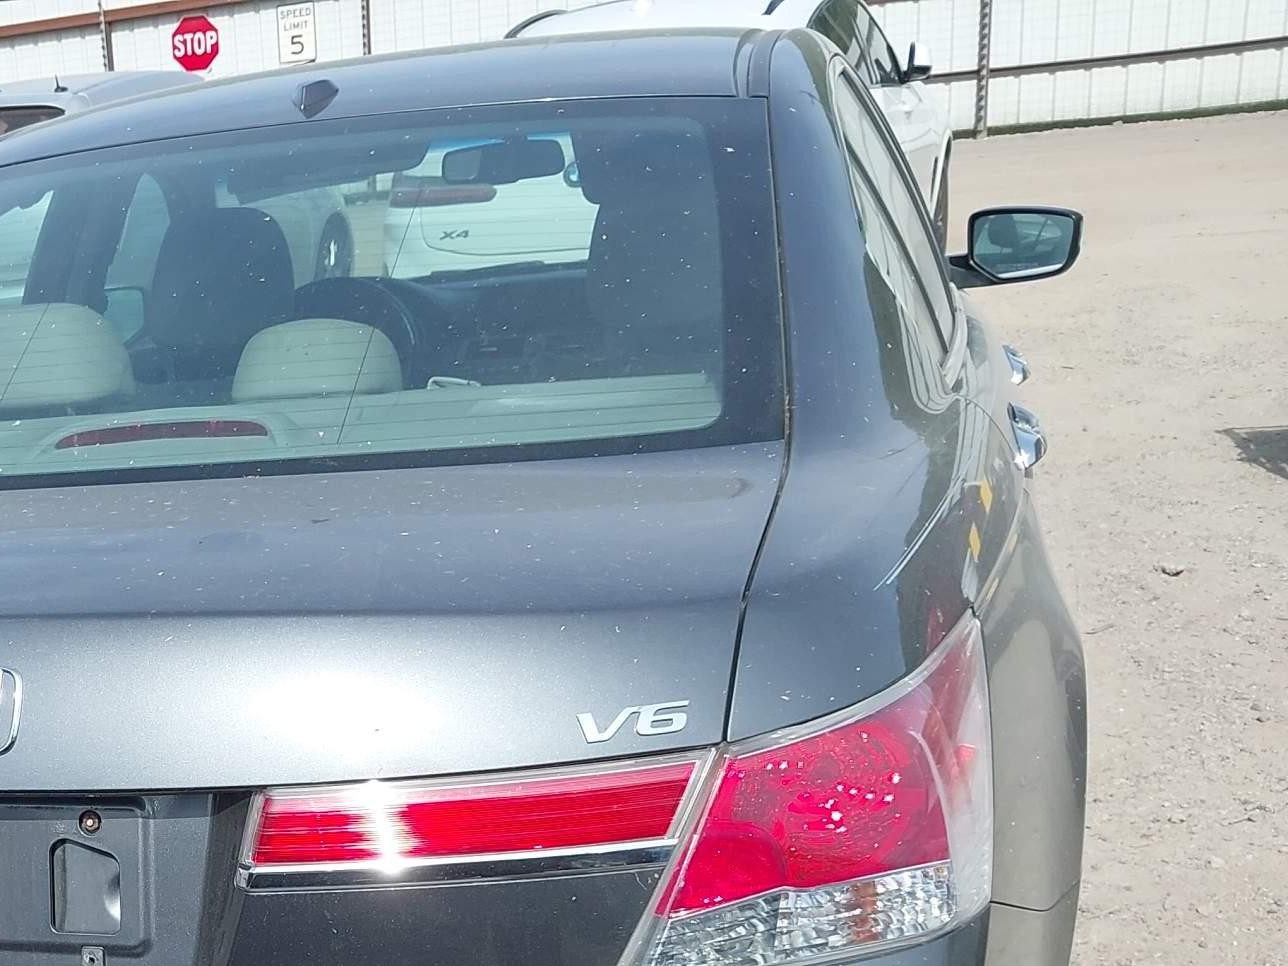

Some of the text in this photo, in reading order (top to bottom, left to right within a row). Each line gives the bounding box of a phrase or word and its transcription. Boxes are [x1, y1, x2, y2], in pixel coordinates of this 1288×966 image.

[280, 7, 312, 20] SPEED
[283, 20, 309, 32] LIMIT
[173, 30, 218, 58] STOP
[290, 34, 305, 55] 5
[439, 229, 470, 241] X4
[575, 699, 690, 744] V6
